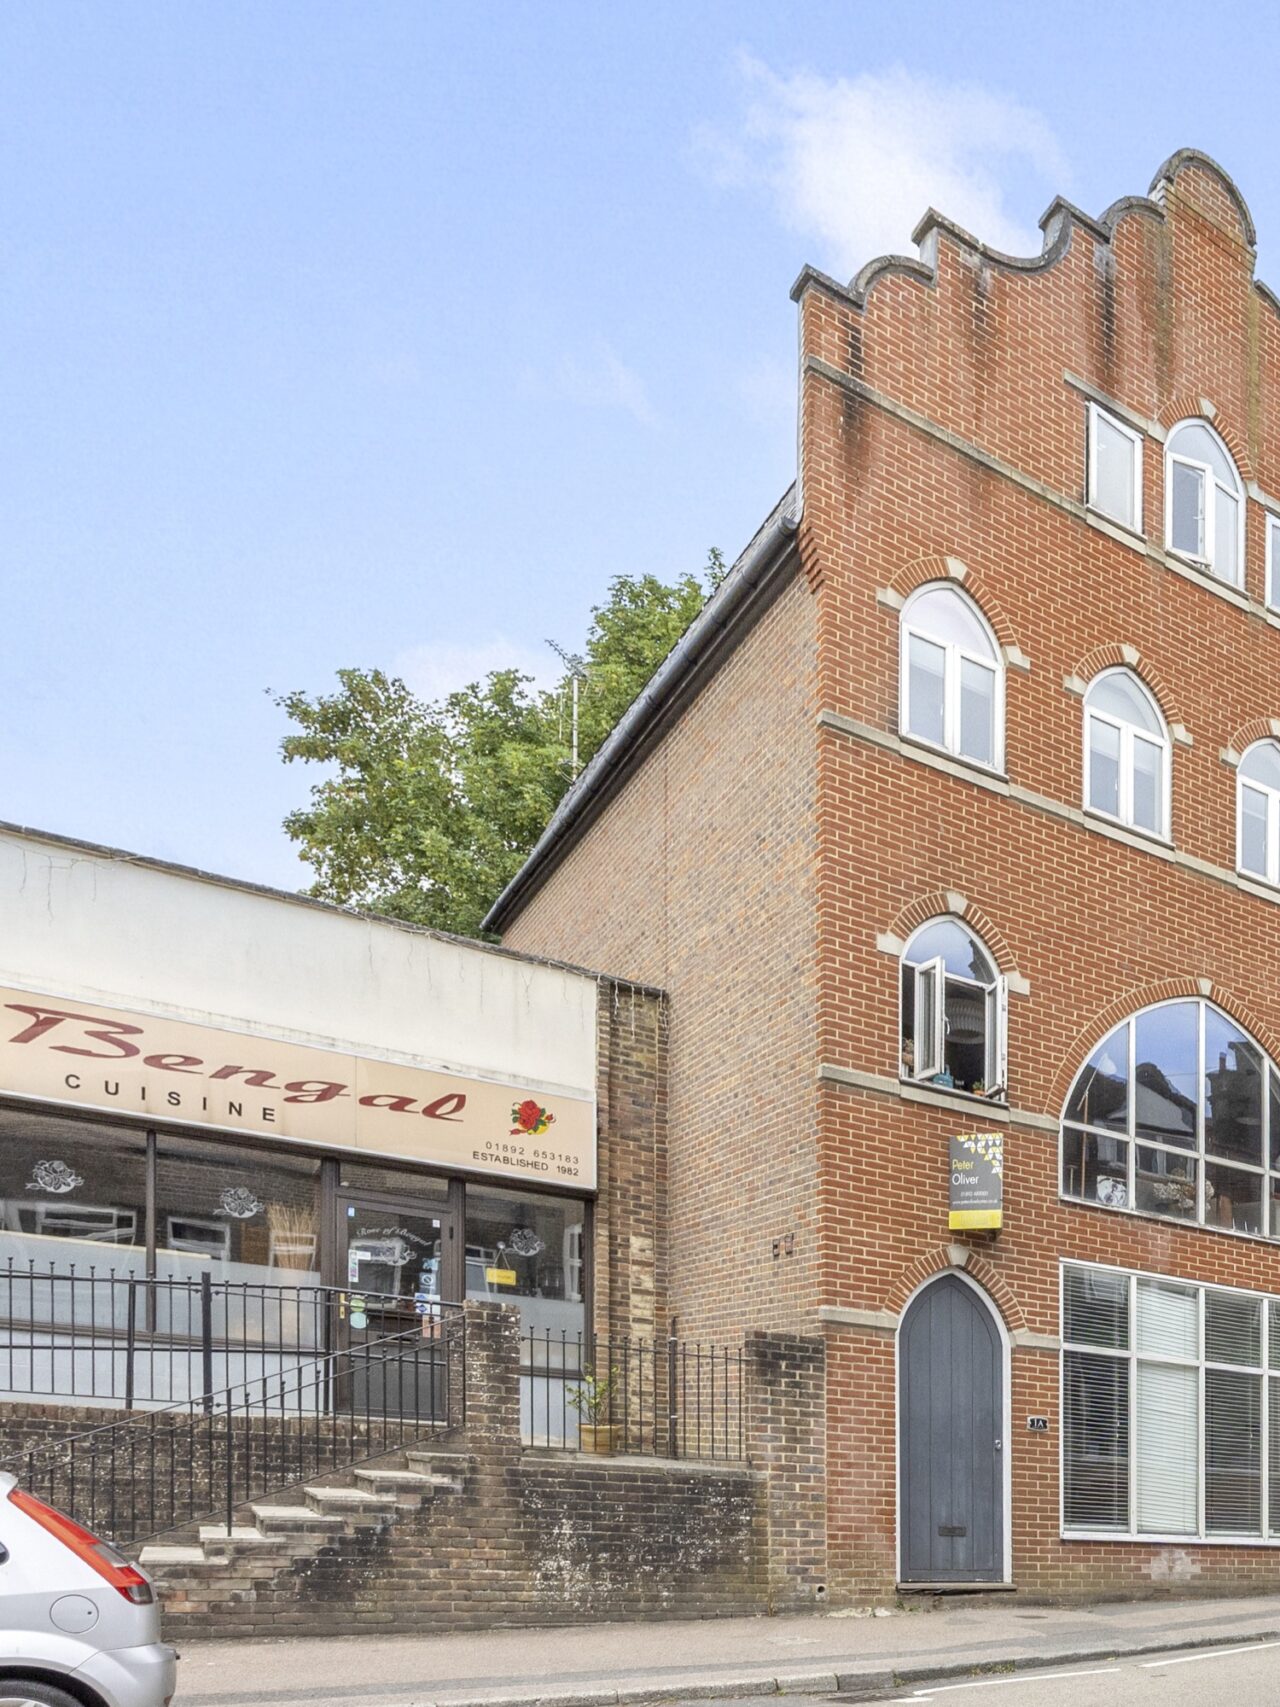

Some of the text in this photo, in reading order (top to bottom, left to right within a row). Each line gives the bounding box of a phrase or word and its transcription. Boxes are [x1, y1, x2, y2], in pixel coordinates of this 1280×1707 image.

[1, 1003, 467, 1123] Bengal
[64, 1073, 276, 1123] CUISINE
[472, 1151, 579, 1176] ESTABLISHED 1982
[485, 1141, 579, 1165] 01892 653183
[952, 1159, 974, 1170] Peter
[952, 1173, 979, 1185] Oliver
